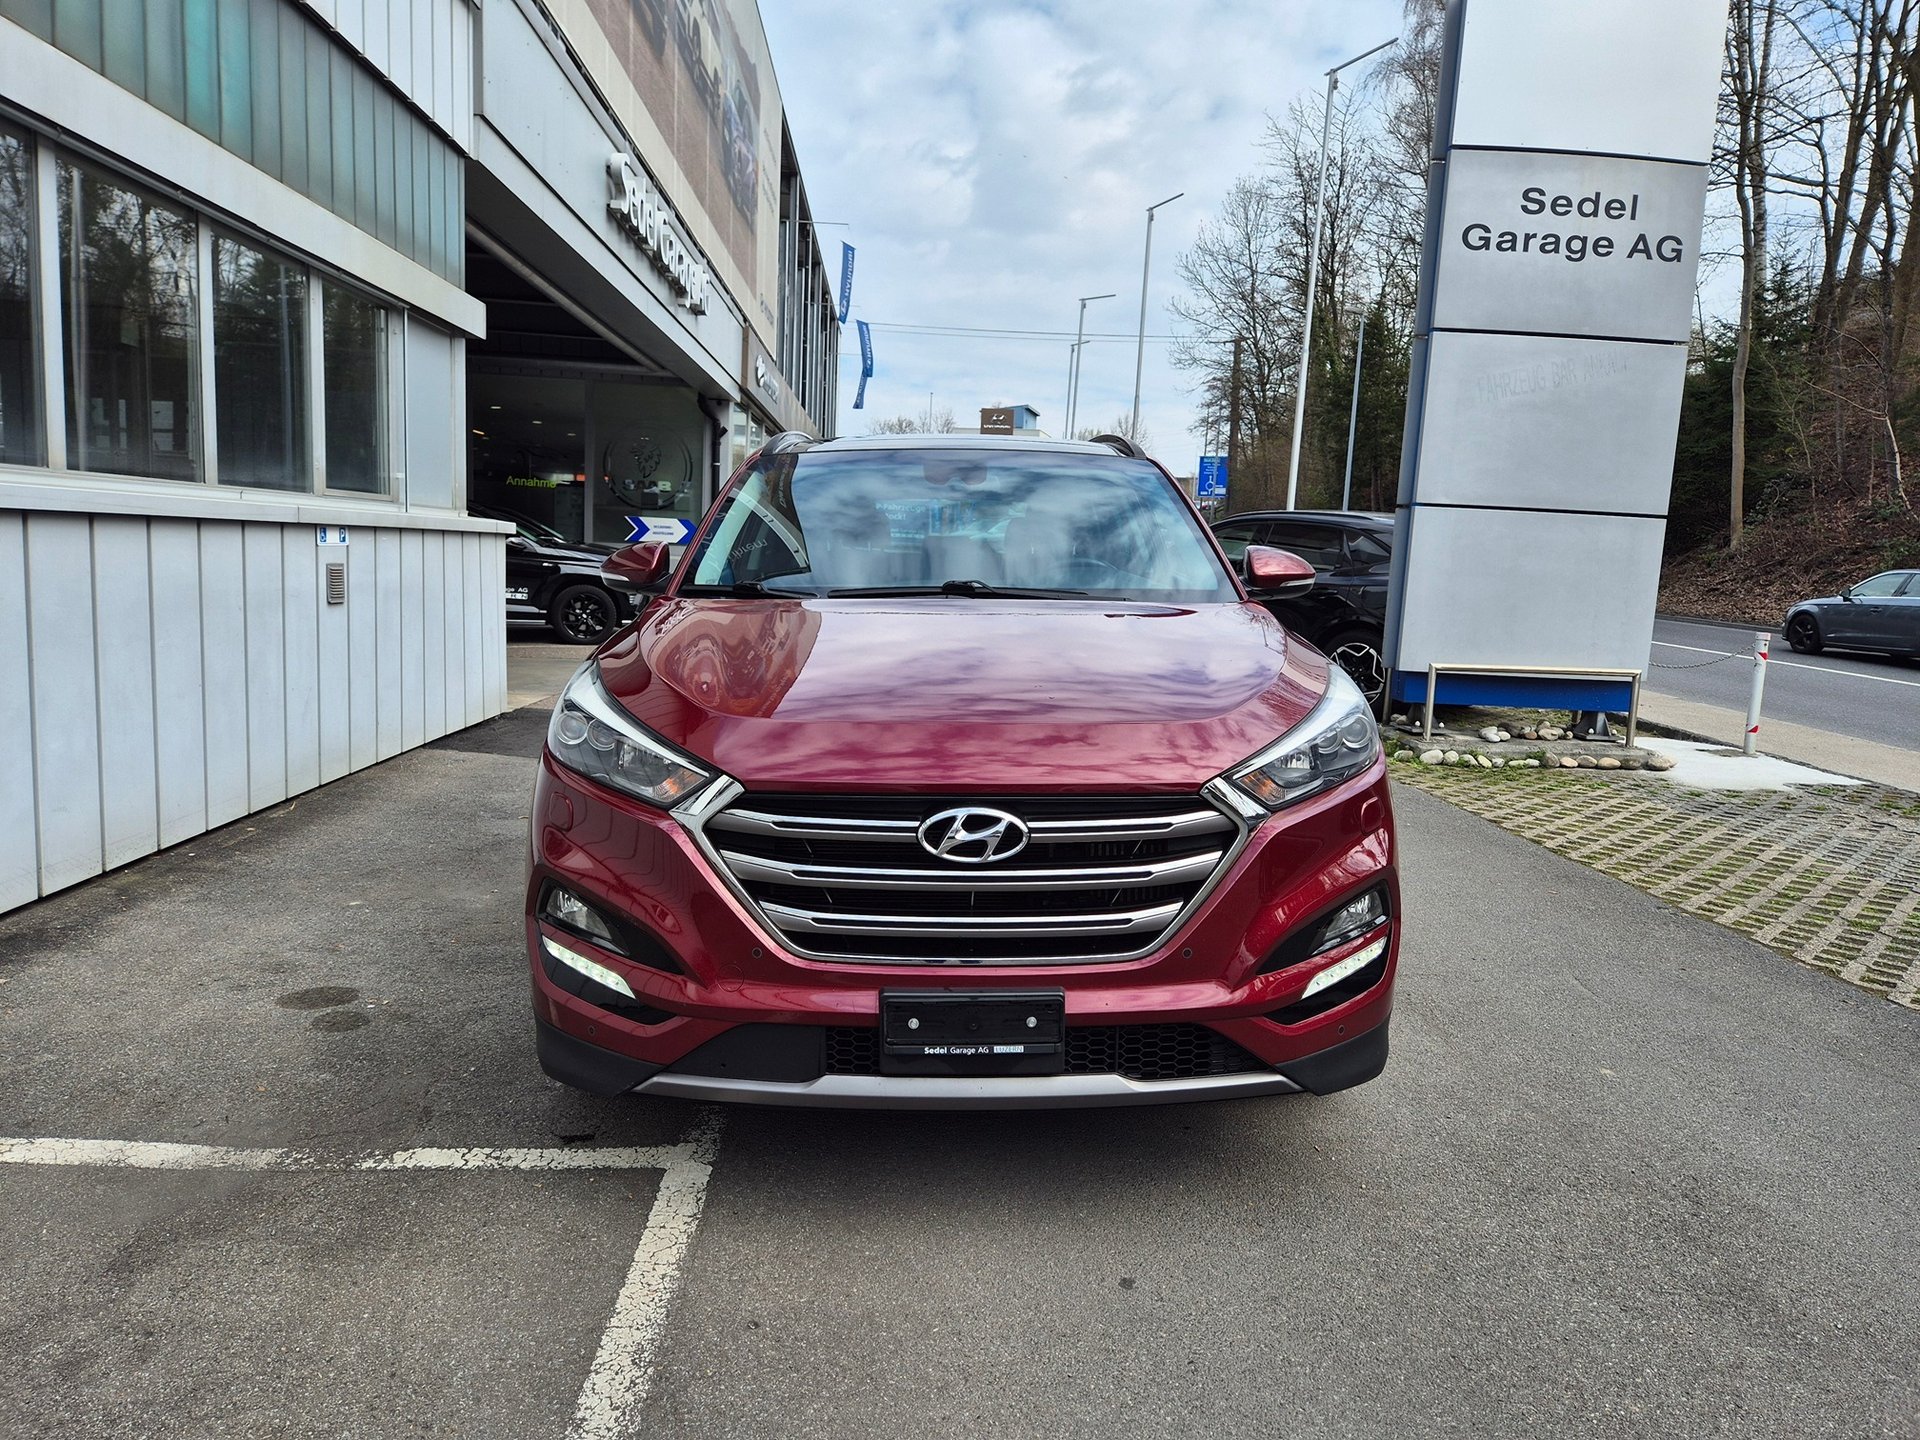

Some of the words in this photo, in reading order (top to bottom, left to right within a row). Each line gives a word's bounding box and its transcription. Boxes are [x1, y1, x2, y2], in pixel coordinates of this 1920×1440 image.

[1520, 187, 1639, 221] Sedel
[1461, 223, 1615, 262] Garage
[1626, 233, 1684, 263] AG
[924, 1046, 947, 1054] Sedel
[950, 1046, 976, 1055] Garage
